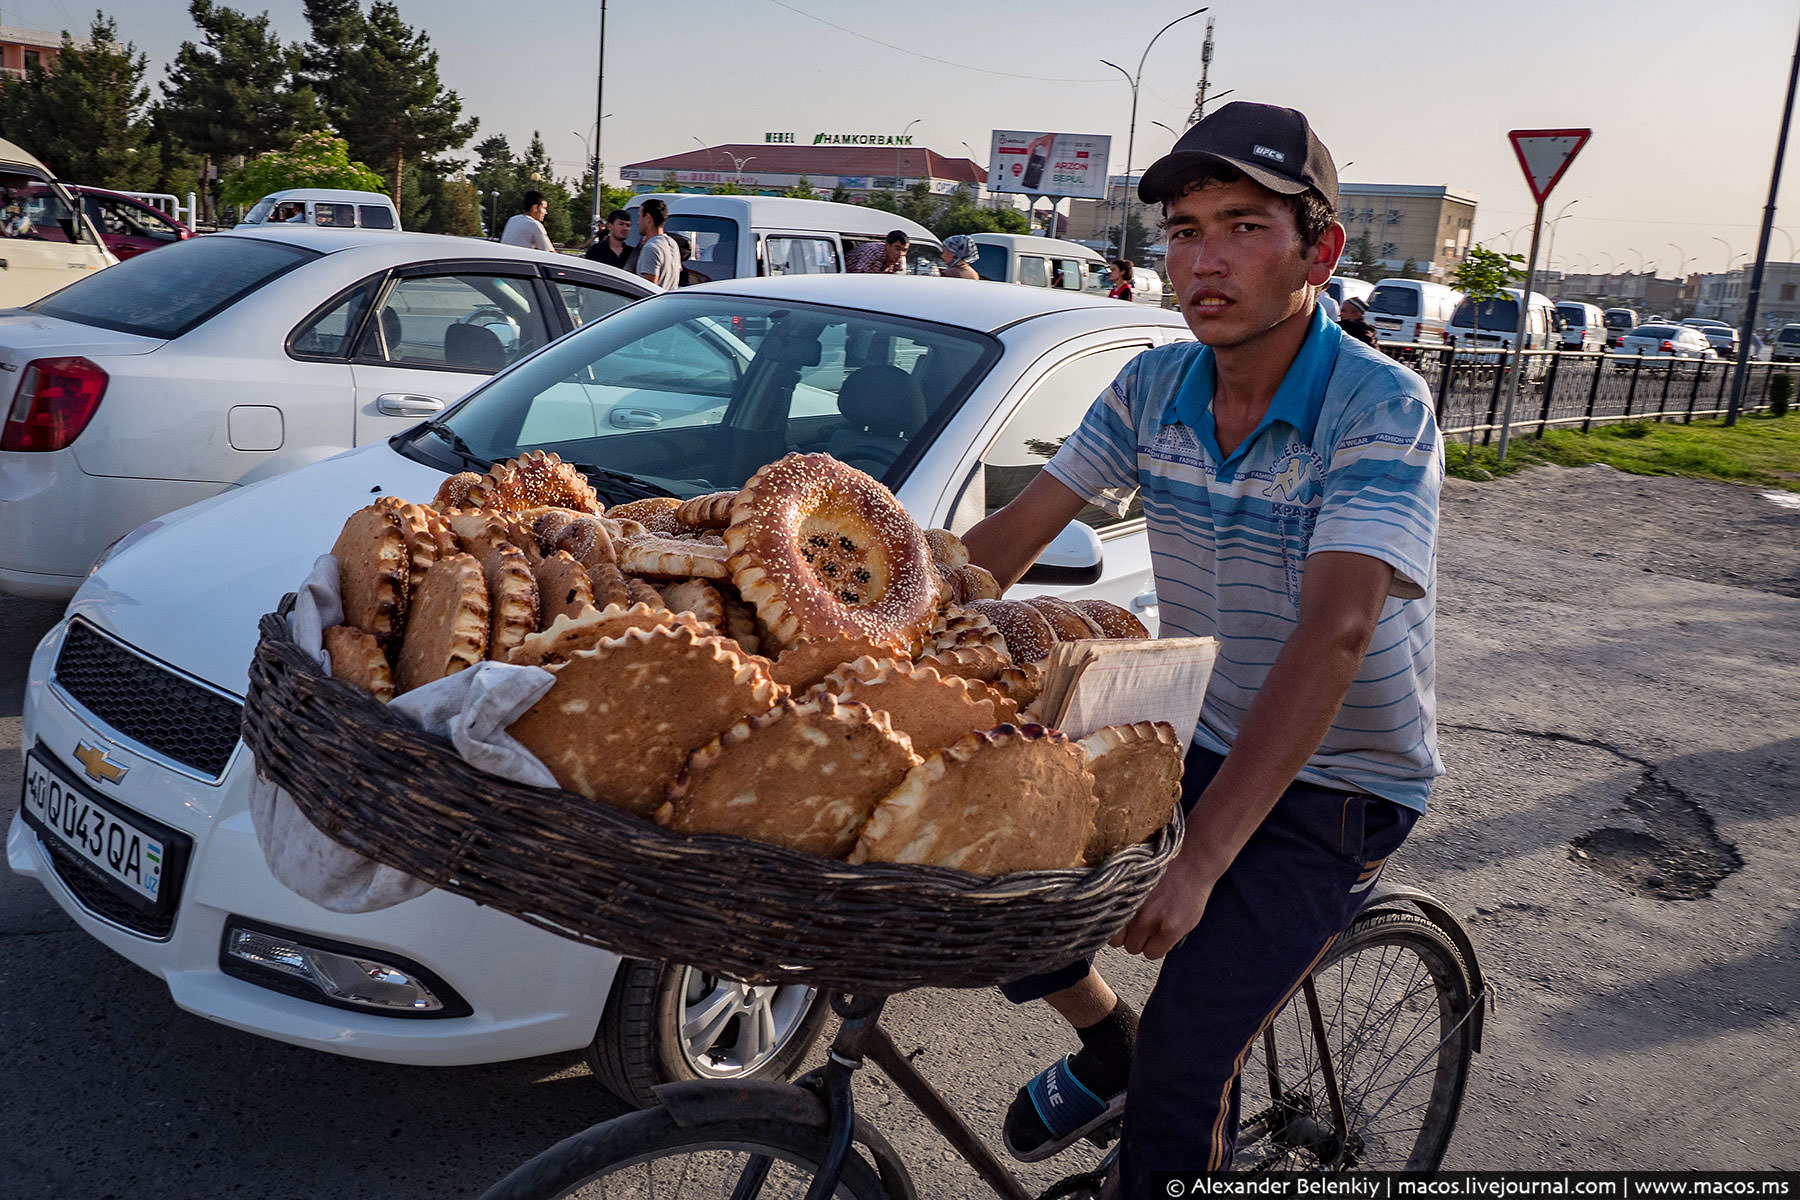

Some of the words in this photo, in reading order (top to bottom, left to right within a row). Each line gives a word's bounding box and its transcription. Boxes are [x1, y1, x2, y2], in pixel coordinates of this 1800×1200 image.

[823, 134, 913, 146] HAMKORBANK
[1255, 147, 1276, 158] UFC
[1053, 162, 1088, 170] ARZON
[1052, 174, 1085, 183] BEPUL
[143, 872, 159, 894] UZ
[1046, 1066, 1064, 1108] NIKE
